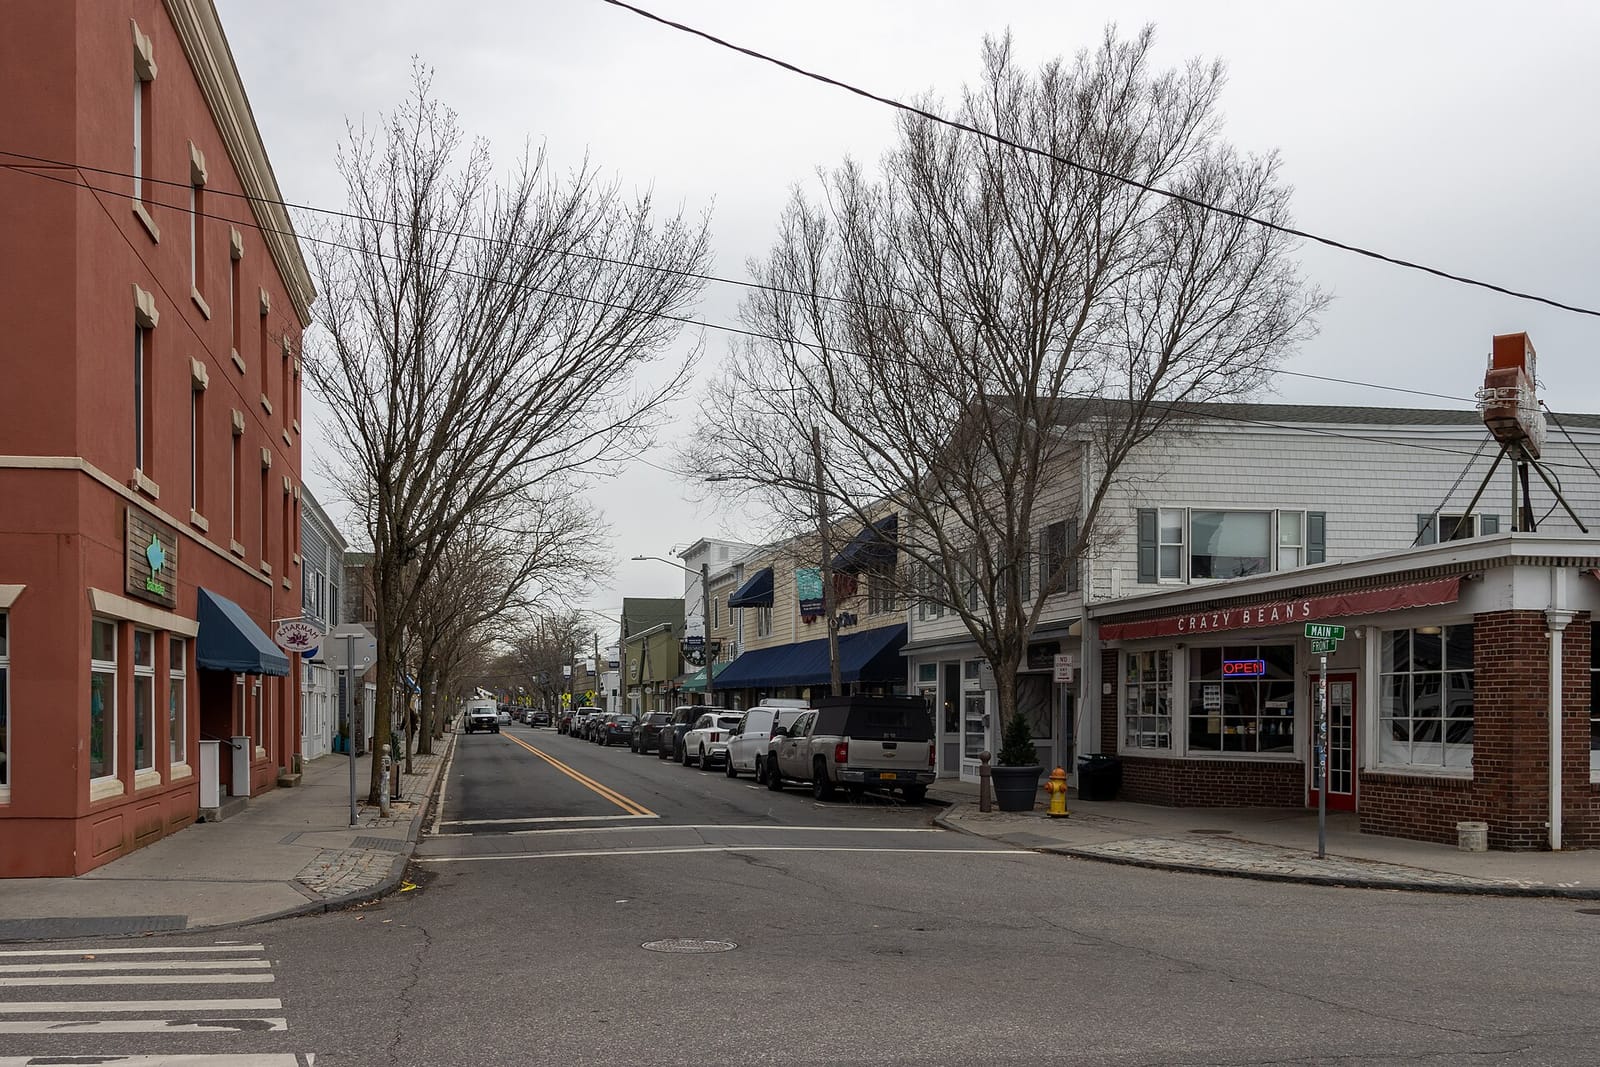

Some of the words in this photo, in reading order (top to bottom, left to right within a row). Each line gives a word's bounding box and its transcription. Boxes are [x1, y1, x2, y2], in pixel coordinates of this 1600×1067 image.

[1178, 613, 1230, 631] CRAZY
[1243, 602, 1310, 623] BEANS
[278, 624, 320, 639] KHARMAH
[1311, 625, 1332, 637] MAIN
[1312, 640, 1329, 652] FRONT
[1224, 663, 1263, 674] OPEN
